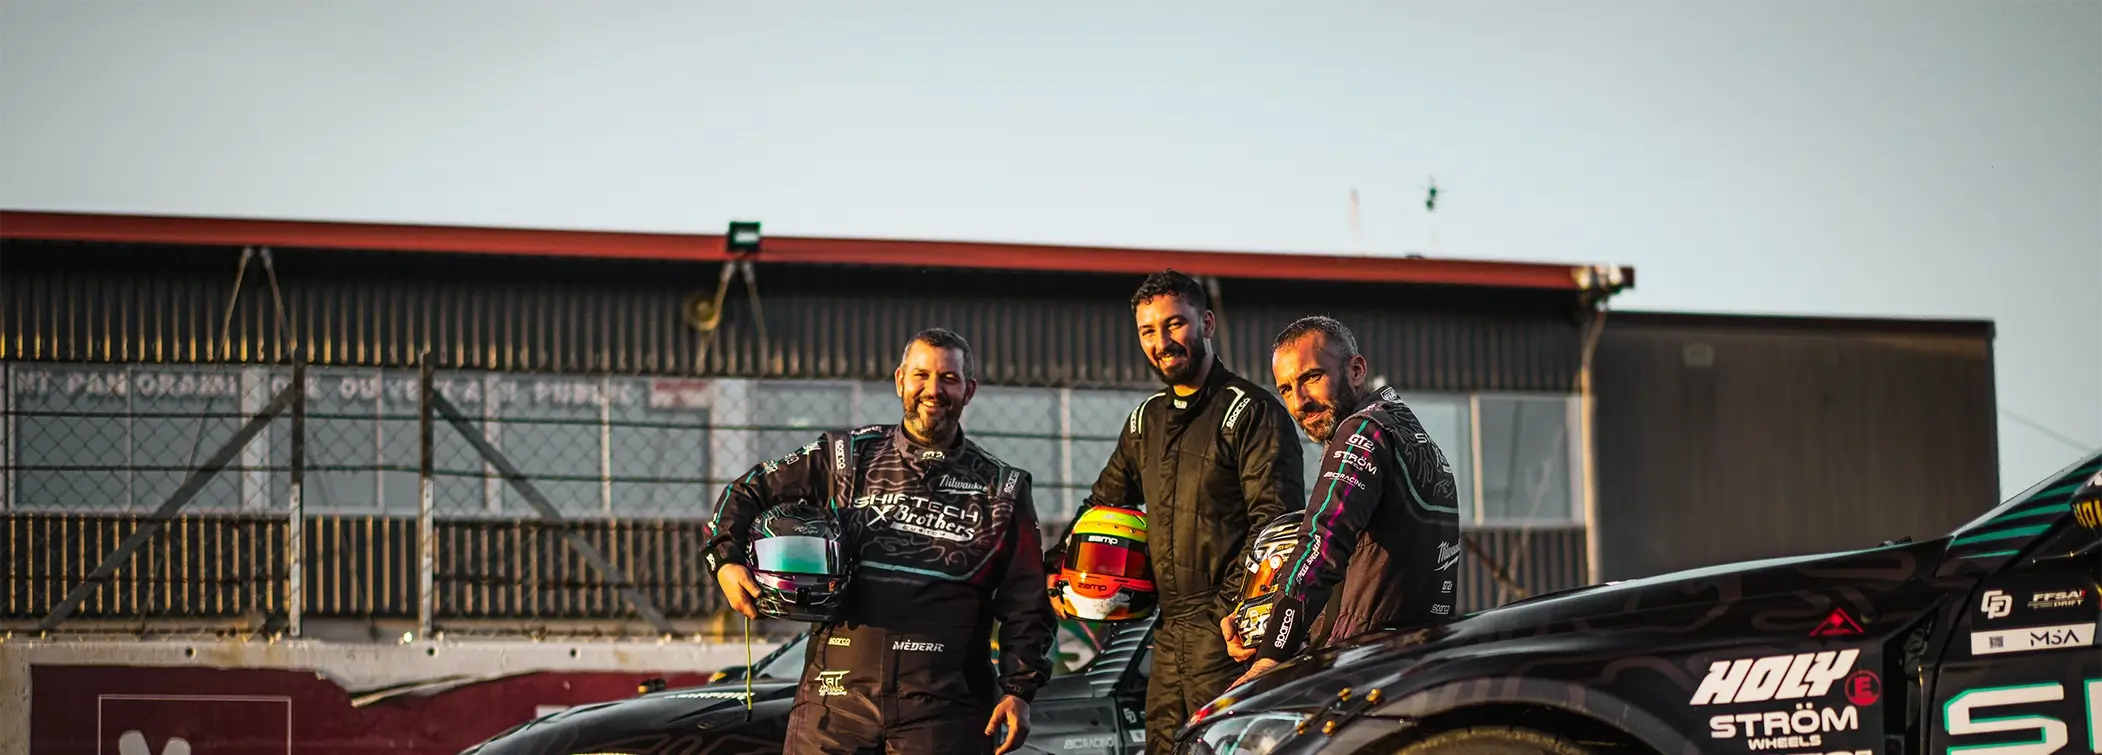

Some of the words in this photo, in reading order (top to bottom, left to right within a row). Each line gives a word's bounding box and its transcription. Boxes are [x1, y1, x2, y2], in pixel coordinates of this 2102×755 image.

[1225, 397, 1251, 430] sparco
[1333, 450, 1378, 475] STRÖM
[894, 504, 976, 541] Brothers
[1088, 535, 1118, 546] zamp
[1078, 582, 1107, 592] zamp
[1275, 608, 1296, 649] sparco
[1689, 648, 1860, 706] HOLY
[1709, 702, 1859, 739] STRÖM
[1747, 734, 1822, 750] WHEELS
